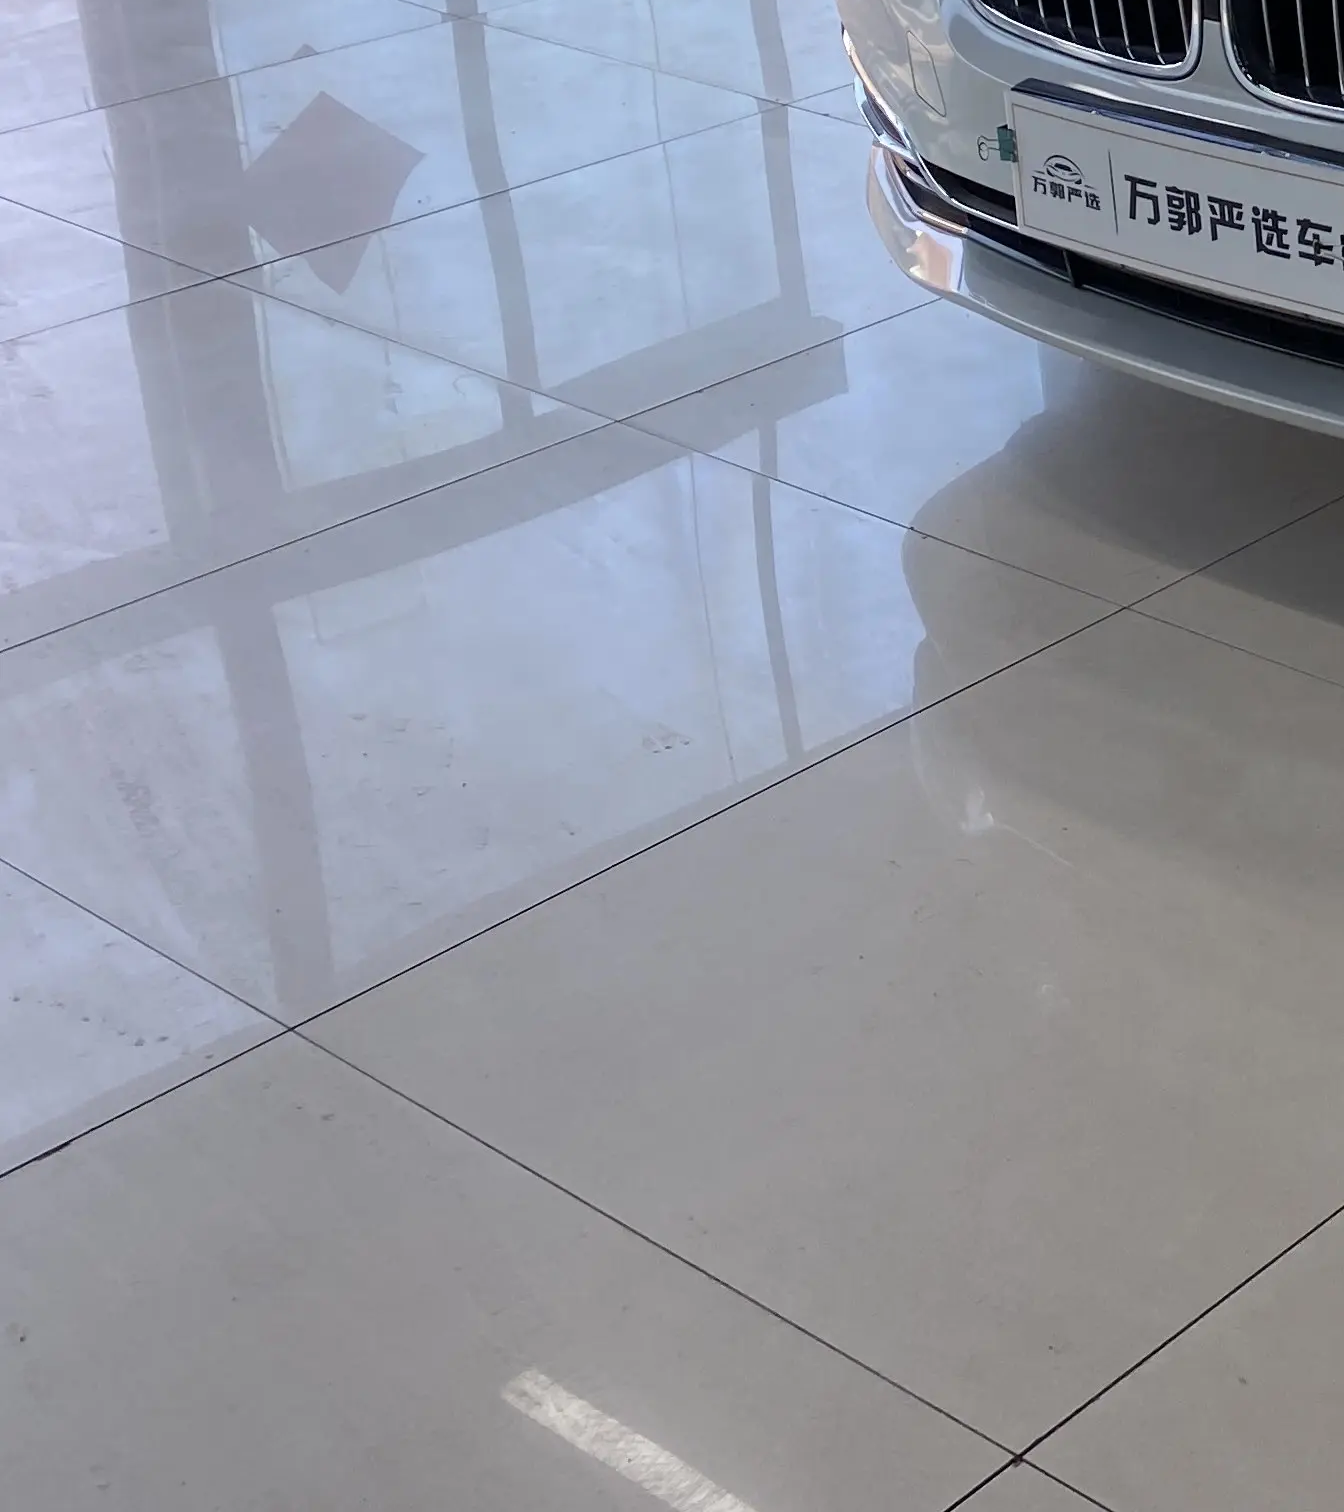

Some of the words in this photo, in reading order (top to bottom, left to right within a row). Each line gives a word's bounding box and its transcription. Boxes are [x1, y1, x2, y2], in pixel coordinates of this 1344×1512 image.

[1032, 175, 1102, 211] 万郭严选
[1124, 174, 1335, 267] 万郭严选车
